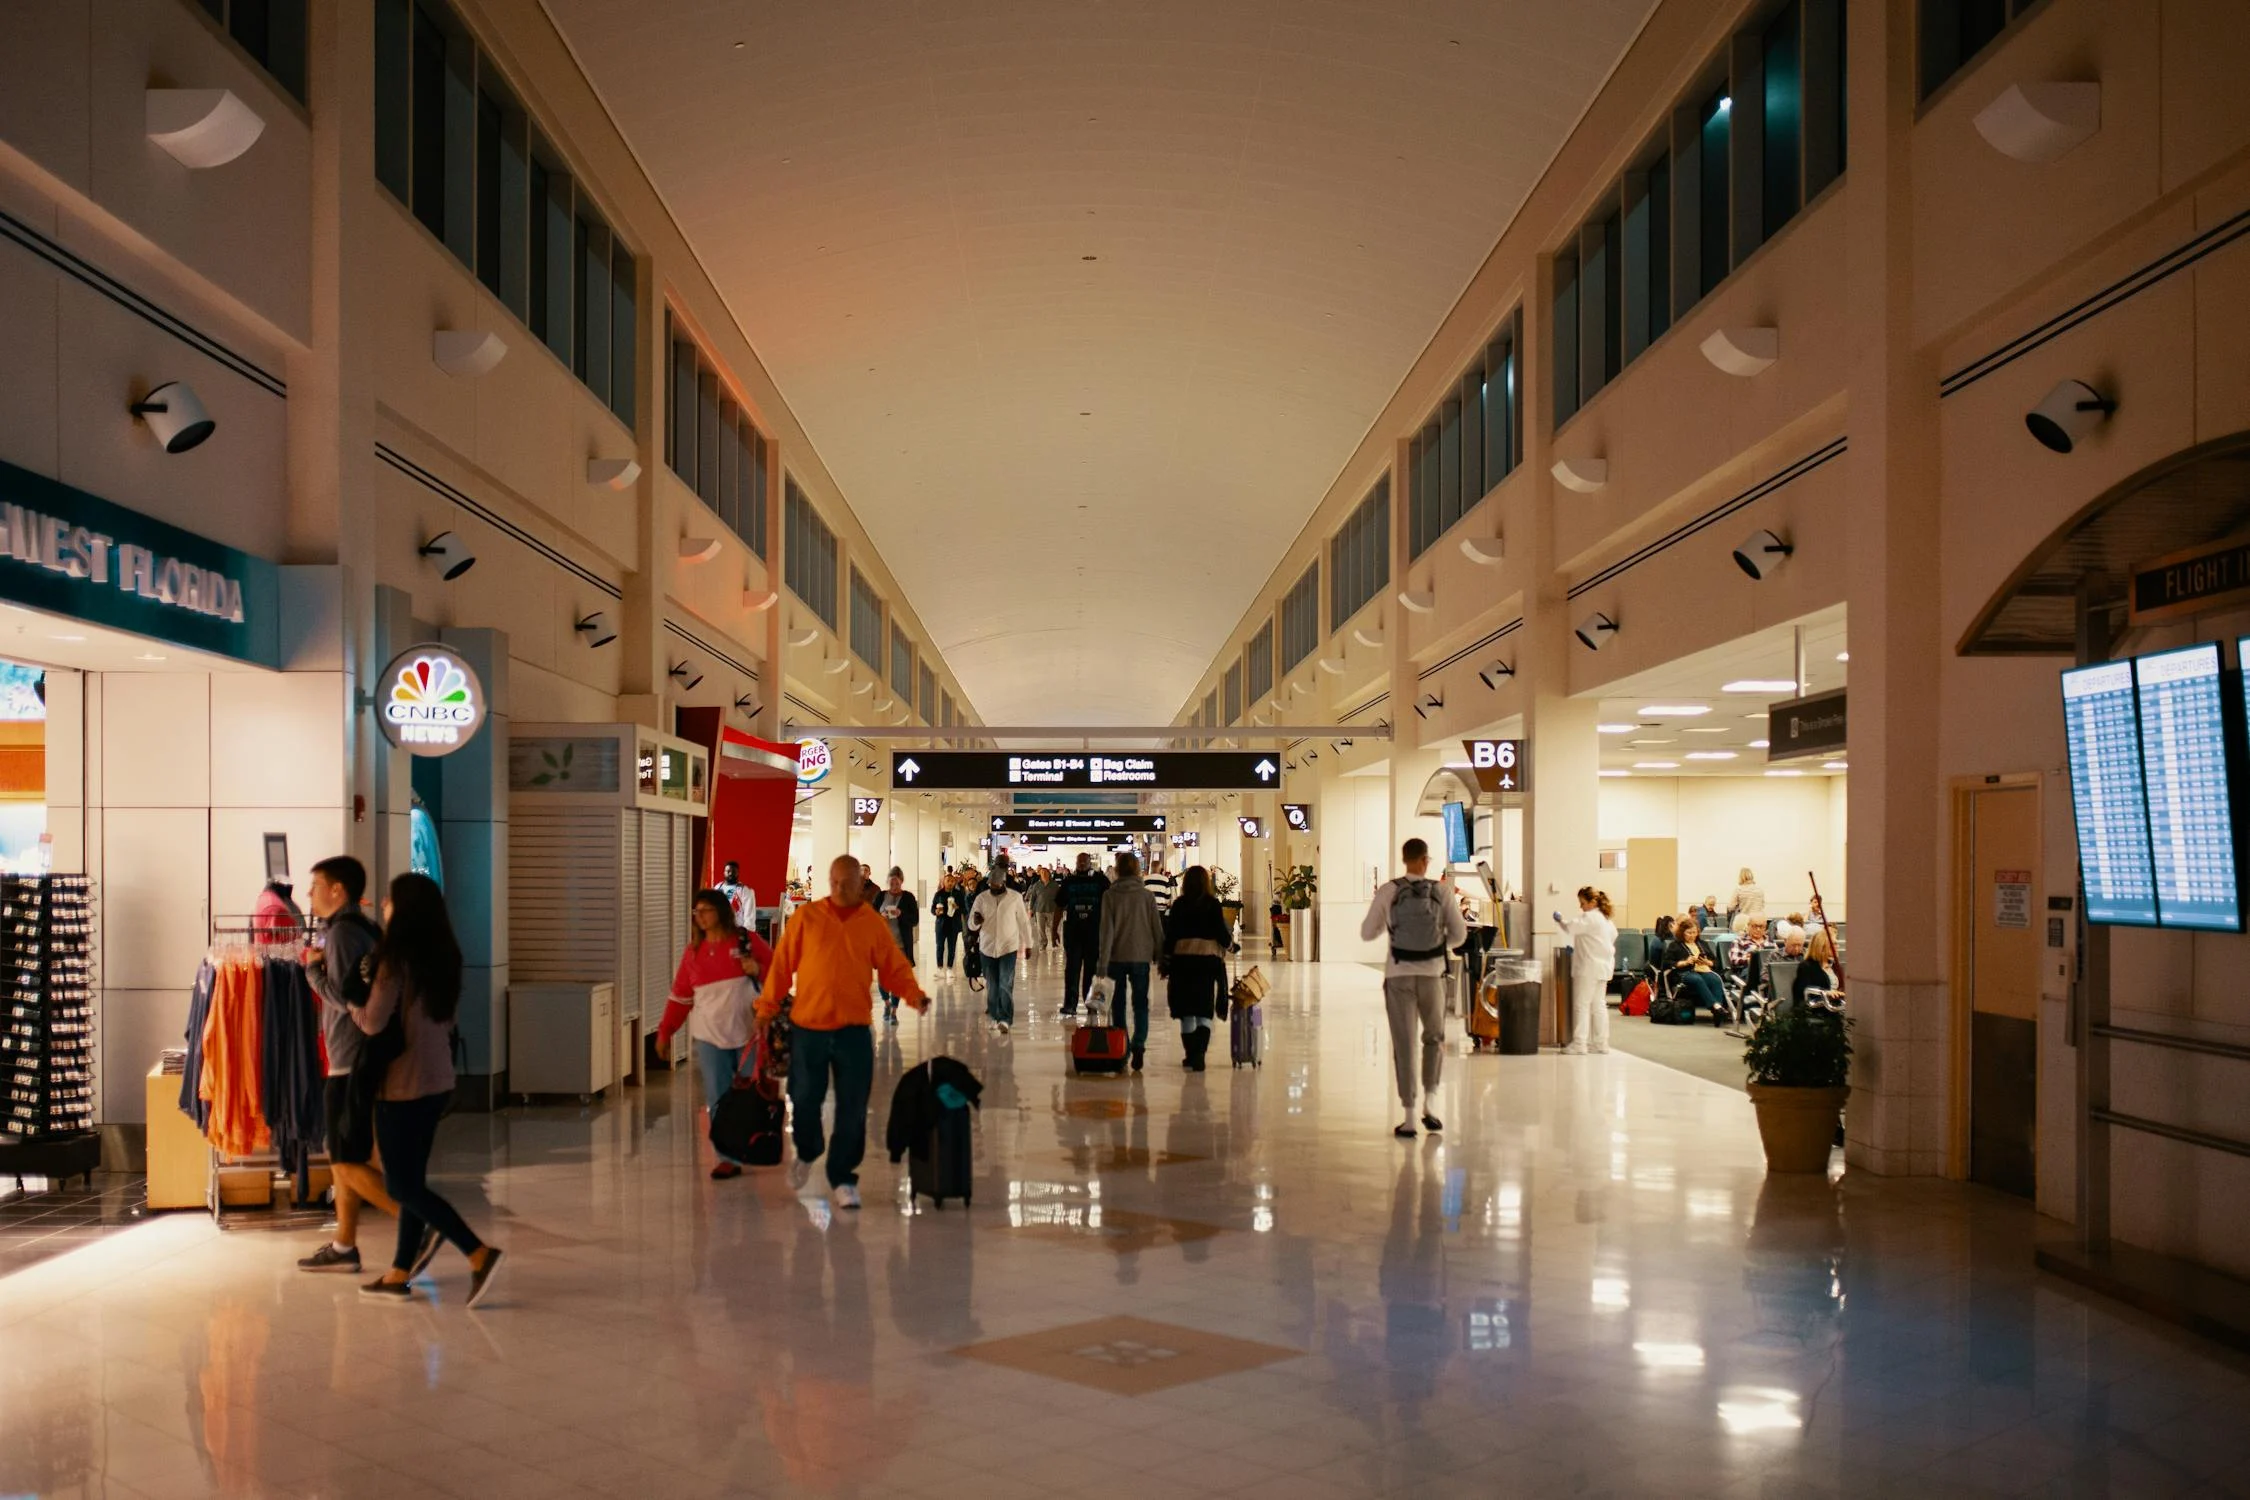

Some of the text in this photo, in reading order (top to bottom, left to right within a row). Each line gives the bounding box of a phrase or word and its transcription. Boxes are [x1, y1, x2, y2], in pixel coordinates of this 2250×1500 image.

[2165, 551, 2250, 600] FLIGHT I
[118, 544, 244, 623] FLORIDA
[2160, 656, 2217, 675] DEPARTURES
[2082, 672, 2131, 689] DEPARTURES
[389, 705, 470, 722] CNBC
[400, 724, 458, 744] NEWS
[1473, 742, 1516, 769] B6
[1022, 759, 1084, 770] Gates B1-B4
[1103, 759, 1154, 771] Bag Claim
[1022, 771, 1064, 782] Terminal
[1103, 771, 1156, 781] Restrooms
[854, 799, 877, 814] B3
[980, 838, 991, 846] B1
[1171, 835, 1184, 844] B2
[1183, 832, 1197, 841] B4
